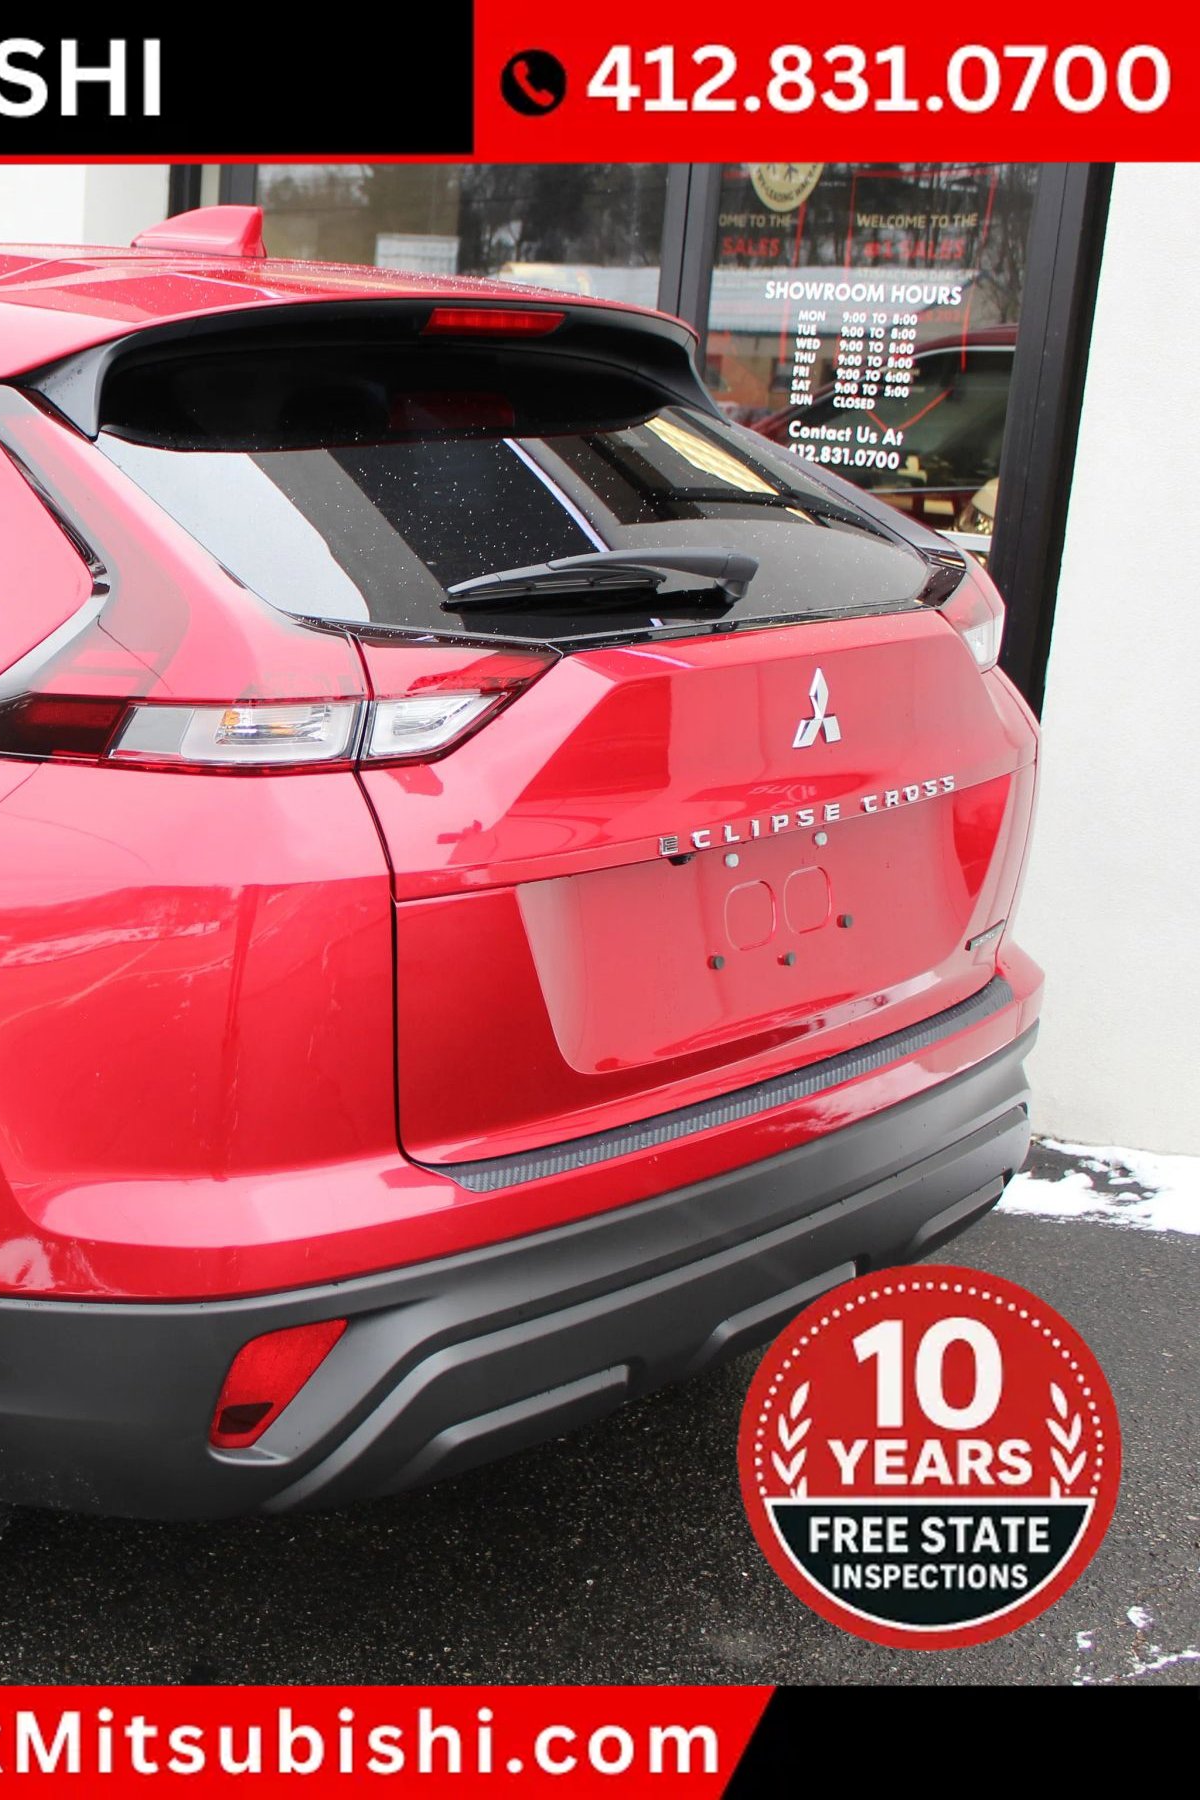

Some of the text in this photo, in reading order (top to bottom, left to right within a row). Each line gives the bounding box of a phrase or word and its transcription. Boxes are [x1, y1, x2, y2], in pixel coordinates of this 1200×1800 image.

[856, 212, 978, 229] WELCOME TO THE
[765, 281, 962, 306] SHOWROOM HOURS
[798, 310, 826, 322] MON
[842, 311, 867, 323] 9:00
[872, 312, 887, 324] TO
[892, 314, 918, 326] 8:00
[797, 324, 916, 340] TUE 9:00 TO 8:00
[795, 338, 914, 354] WED 9:00 TO 8:00
[794, 352, 913, 369] THU 9:00 TO 8:00
[792, 365, 810, 377] FRI
[836, 368, 860, 380] 9:00
[865, 369, 881, 381] TO
[884, 371, 911, 384] 6:00
[791, 379, 909, 398] SAT 9:00 TO 5:00
[789, 393, 875, 410] SUN CLOSED
[788, 420, 904, 446] Contact Us At
[658, 775, 955, 855] ECLIPSE CROSS
